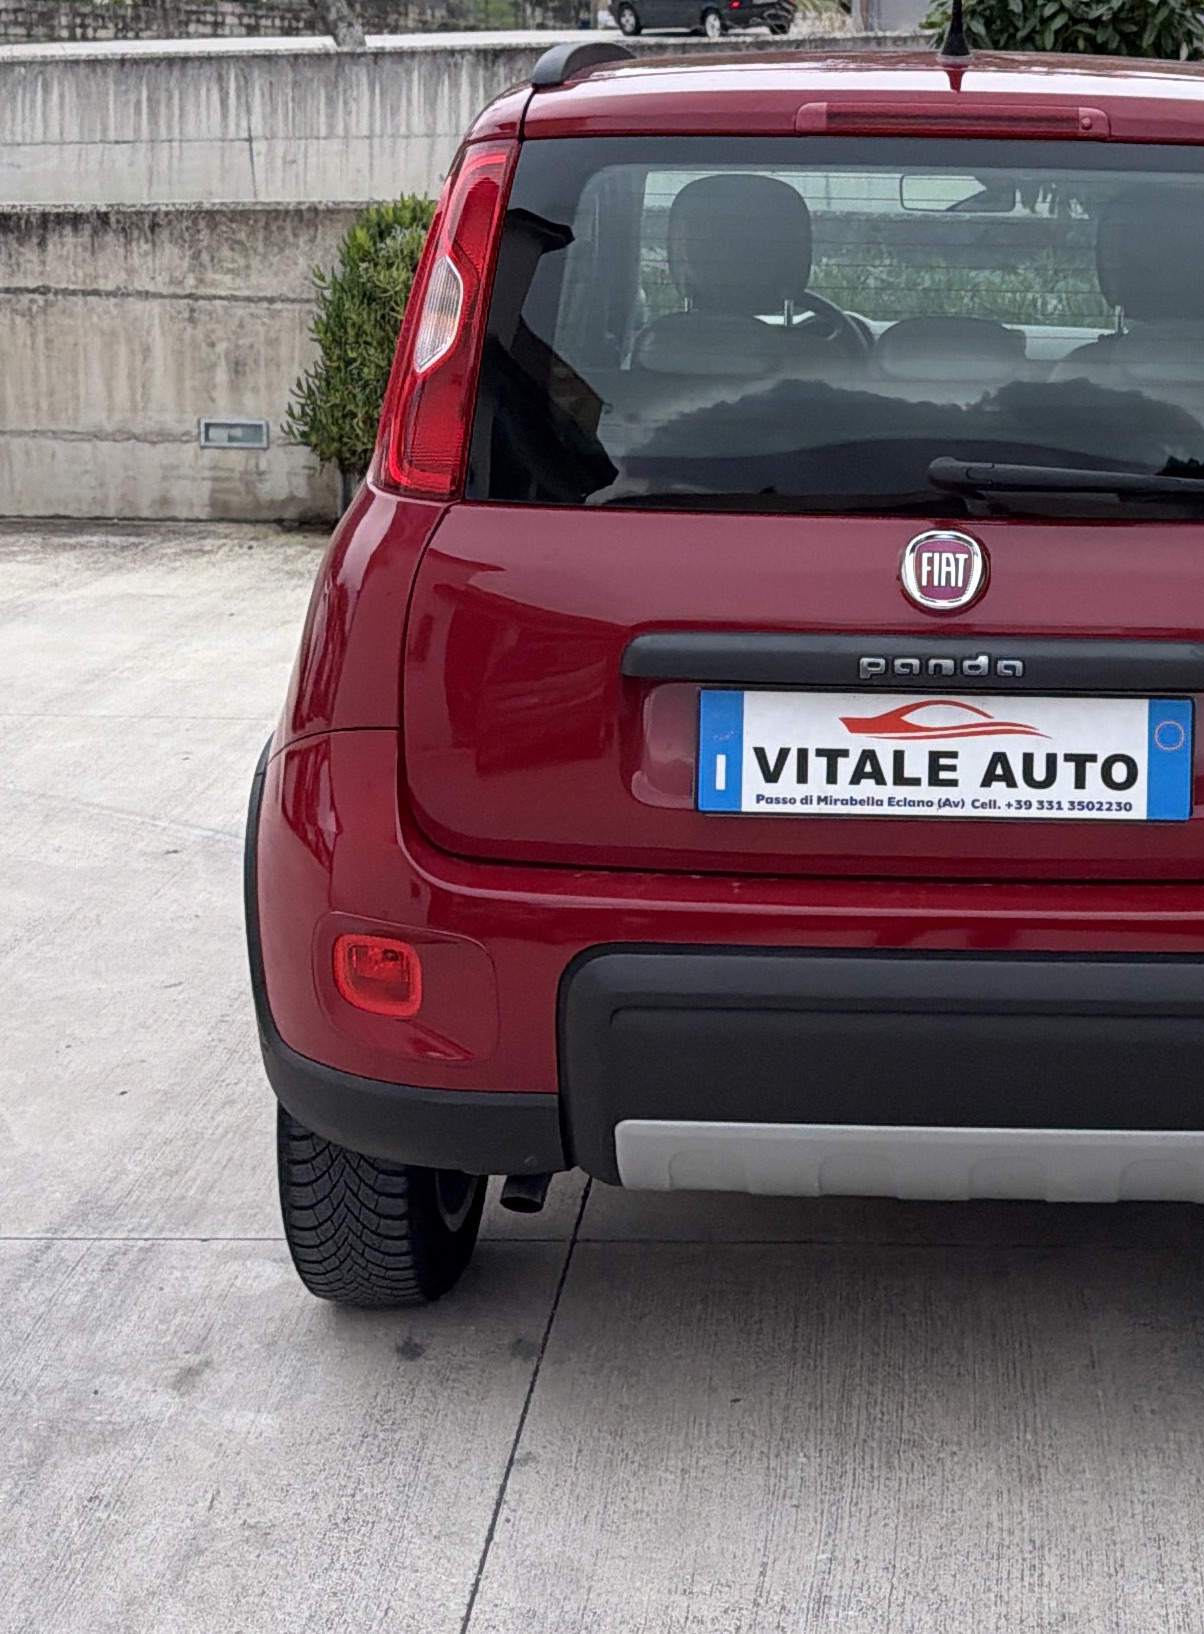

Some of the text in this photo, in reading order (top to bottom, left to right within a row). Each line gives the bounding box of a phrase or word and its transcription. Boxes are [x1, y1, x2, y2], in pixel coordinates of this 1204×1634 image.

[921, 552, 969, 588] FIAT
[859, 655, 1025, 679] panda
[752, 746, 1139, 791] VITALE AUTO
[755, 794, 1133, 813] Passo di Mirabella Eclano (Av) Cell. +39 331 3502230
